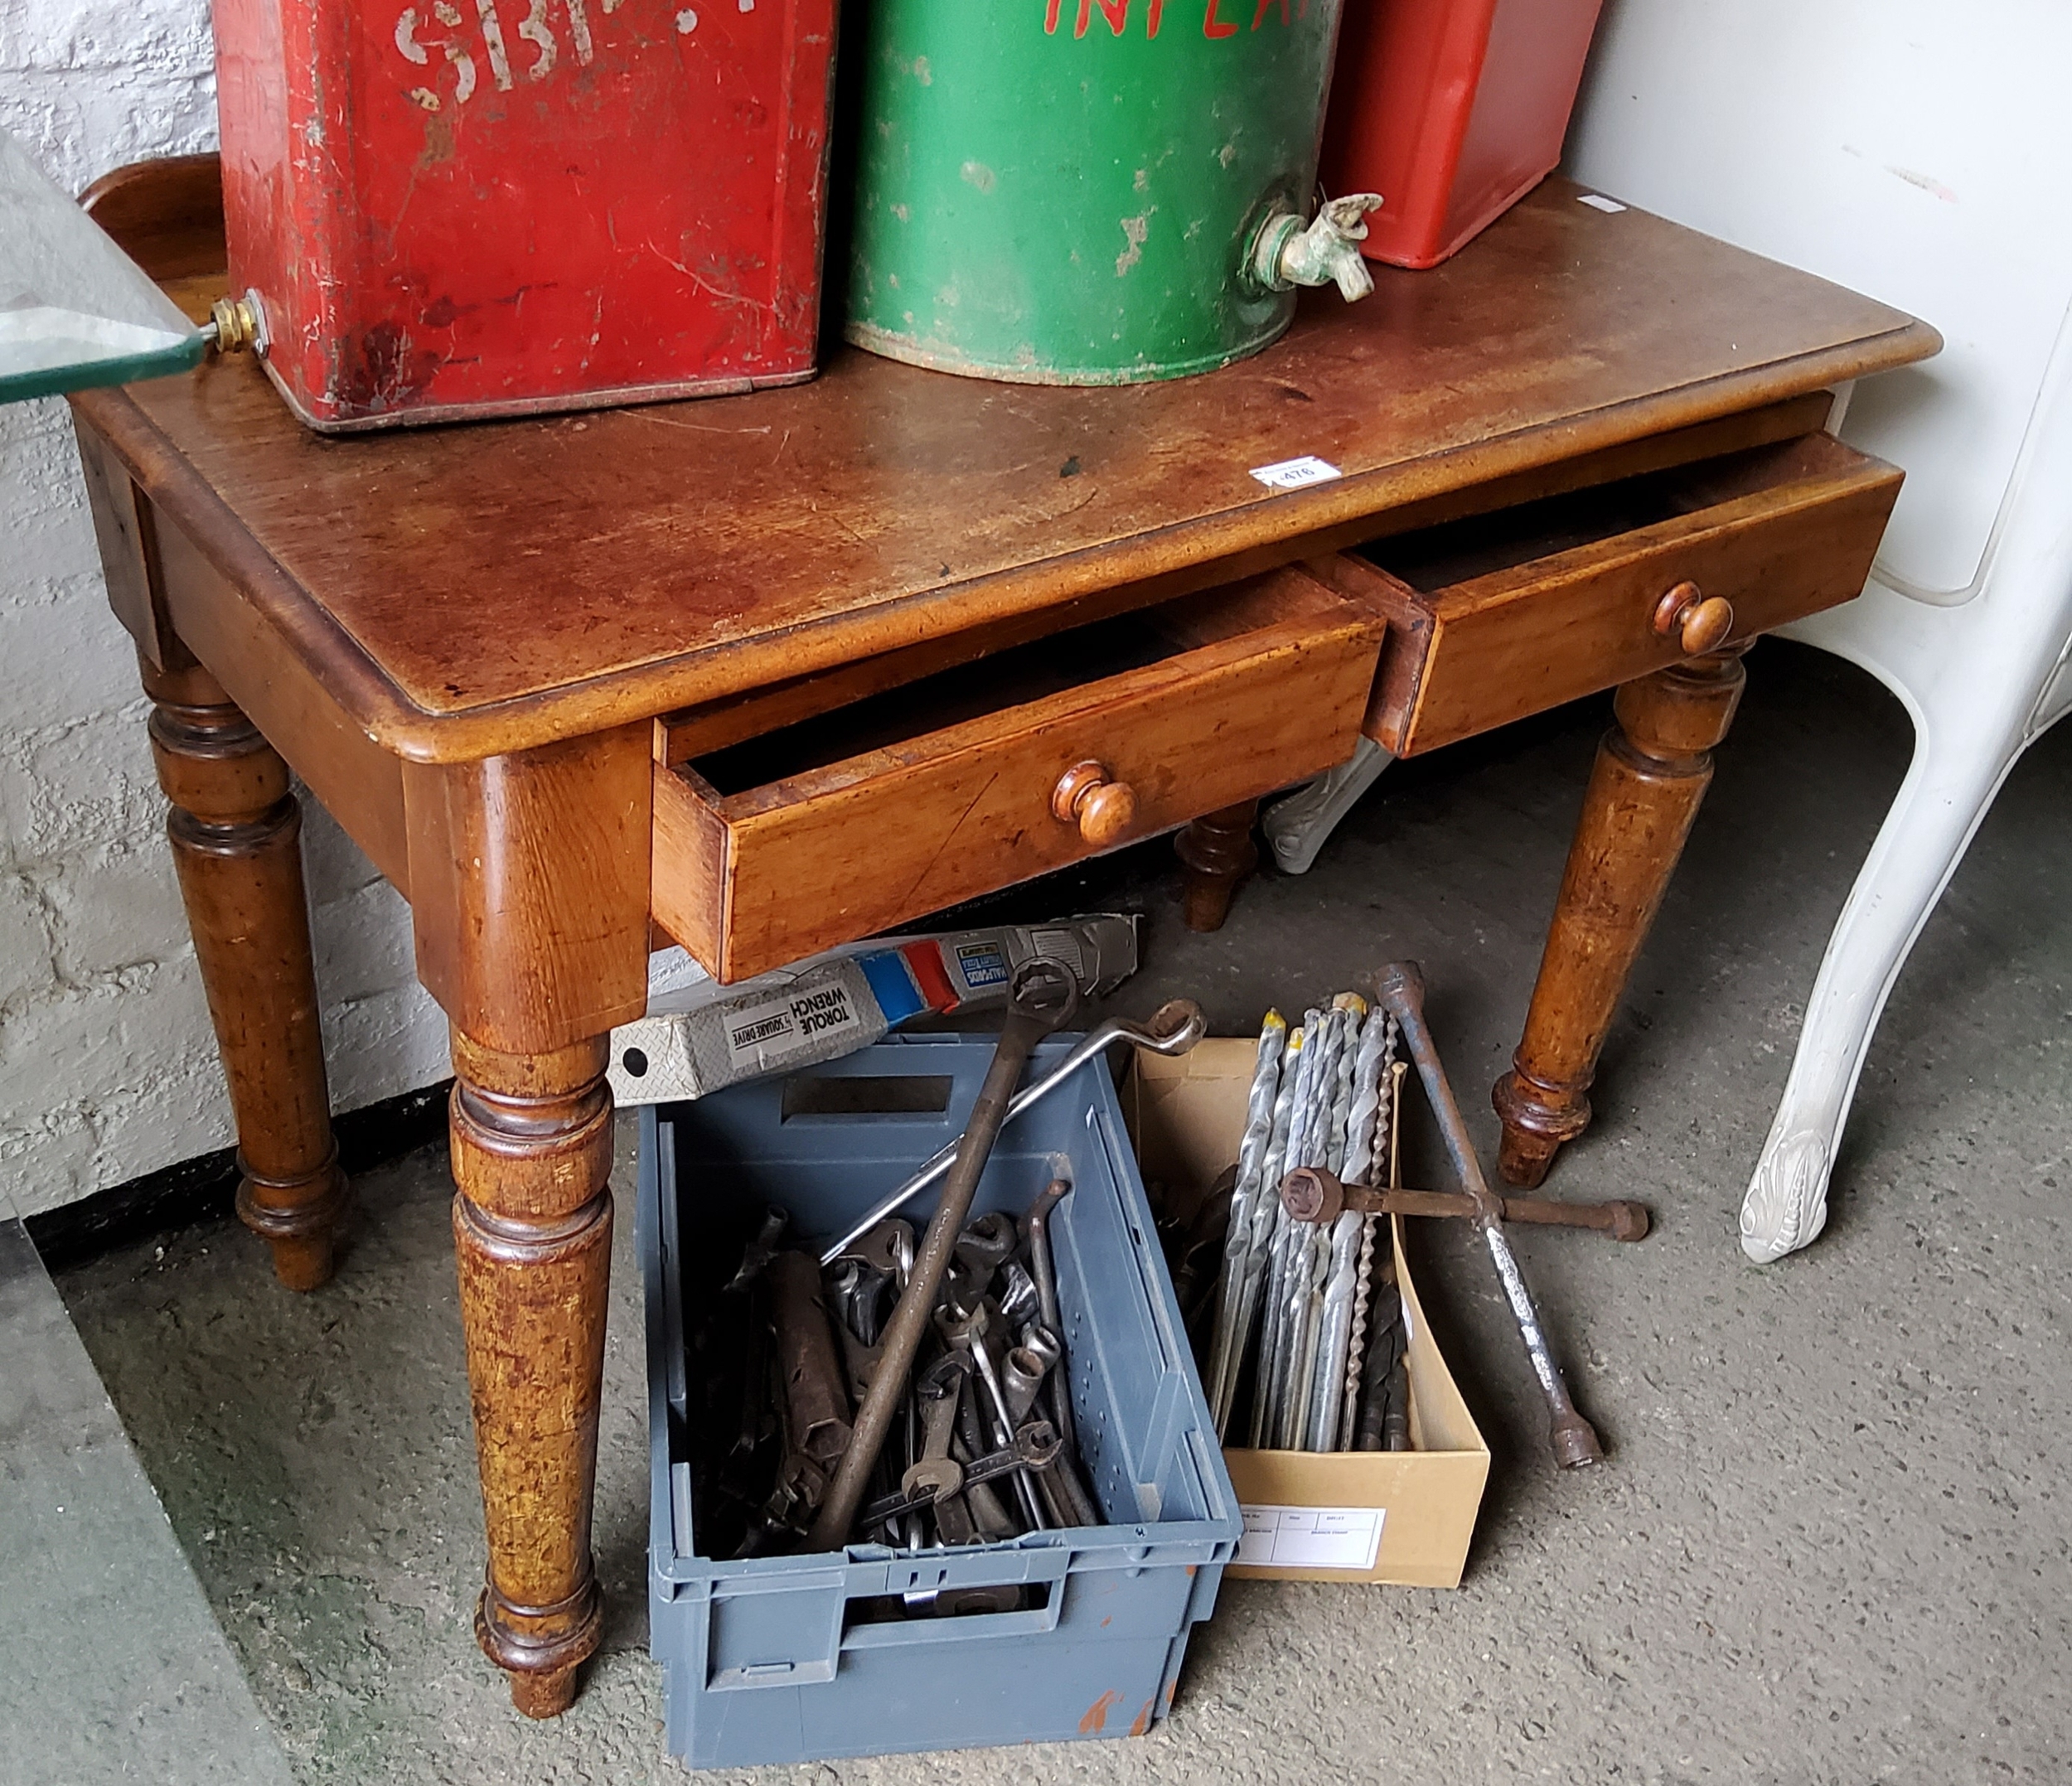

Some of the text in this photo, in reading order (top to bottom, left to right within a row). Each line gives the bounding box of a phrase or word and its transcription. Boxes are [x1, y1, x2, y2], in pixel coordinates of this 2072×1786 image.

[789, 987, 847, 1019] WRENCH
[757, 1017, 785, 1038] SQUARE
[800, 1005, 850, 1035] TORQUE
[733, 1027, 757, 1047] DRIVE
